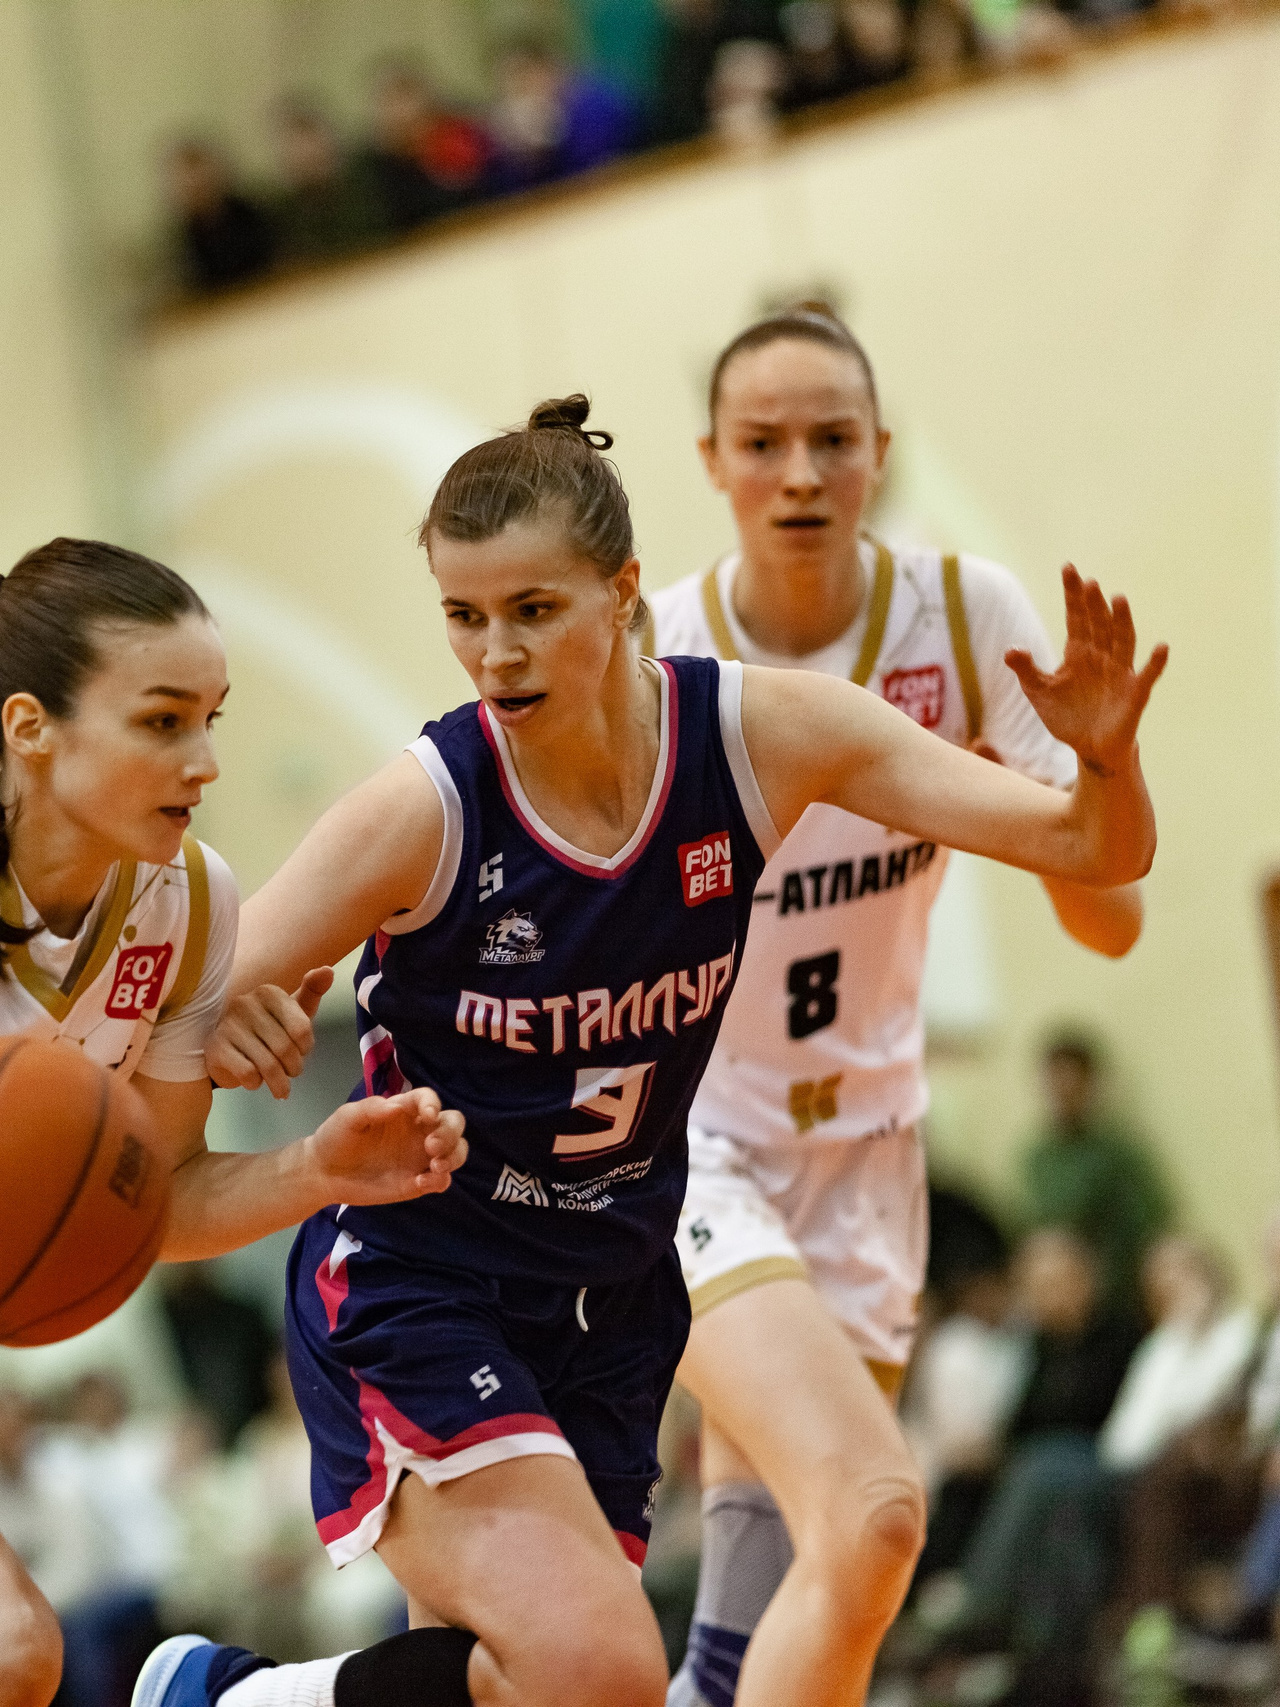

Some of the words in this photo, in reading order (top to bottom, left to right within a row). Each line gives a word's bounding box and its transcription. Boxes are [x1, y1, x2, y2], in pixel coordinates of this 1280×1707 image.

[685, 837, 731, 874] FON
[689, 862, 732, 899] BET
[455, 940, 736, 1055] МЕТАЛЛУР
[786, 949, 841, 1040] 8
[550, 1060, 657, 1163] 9
